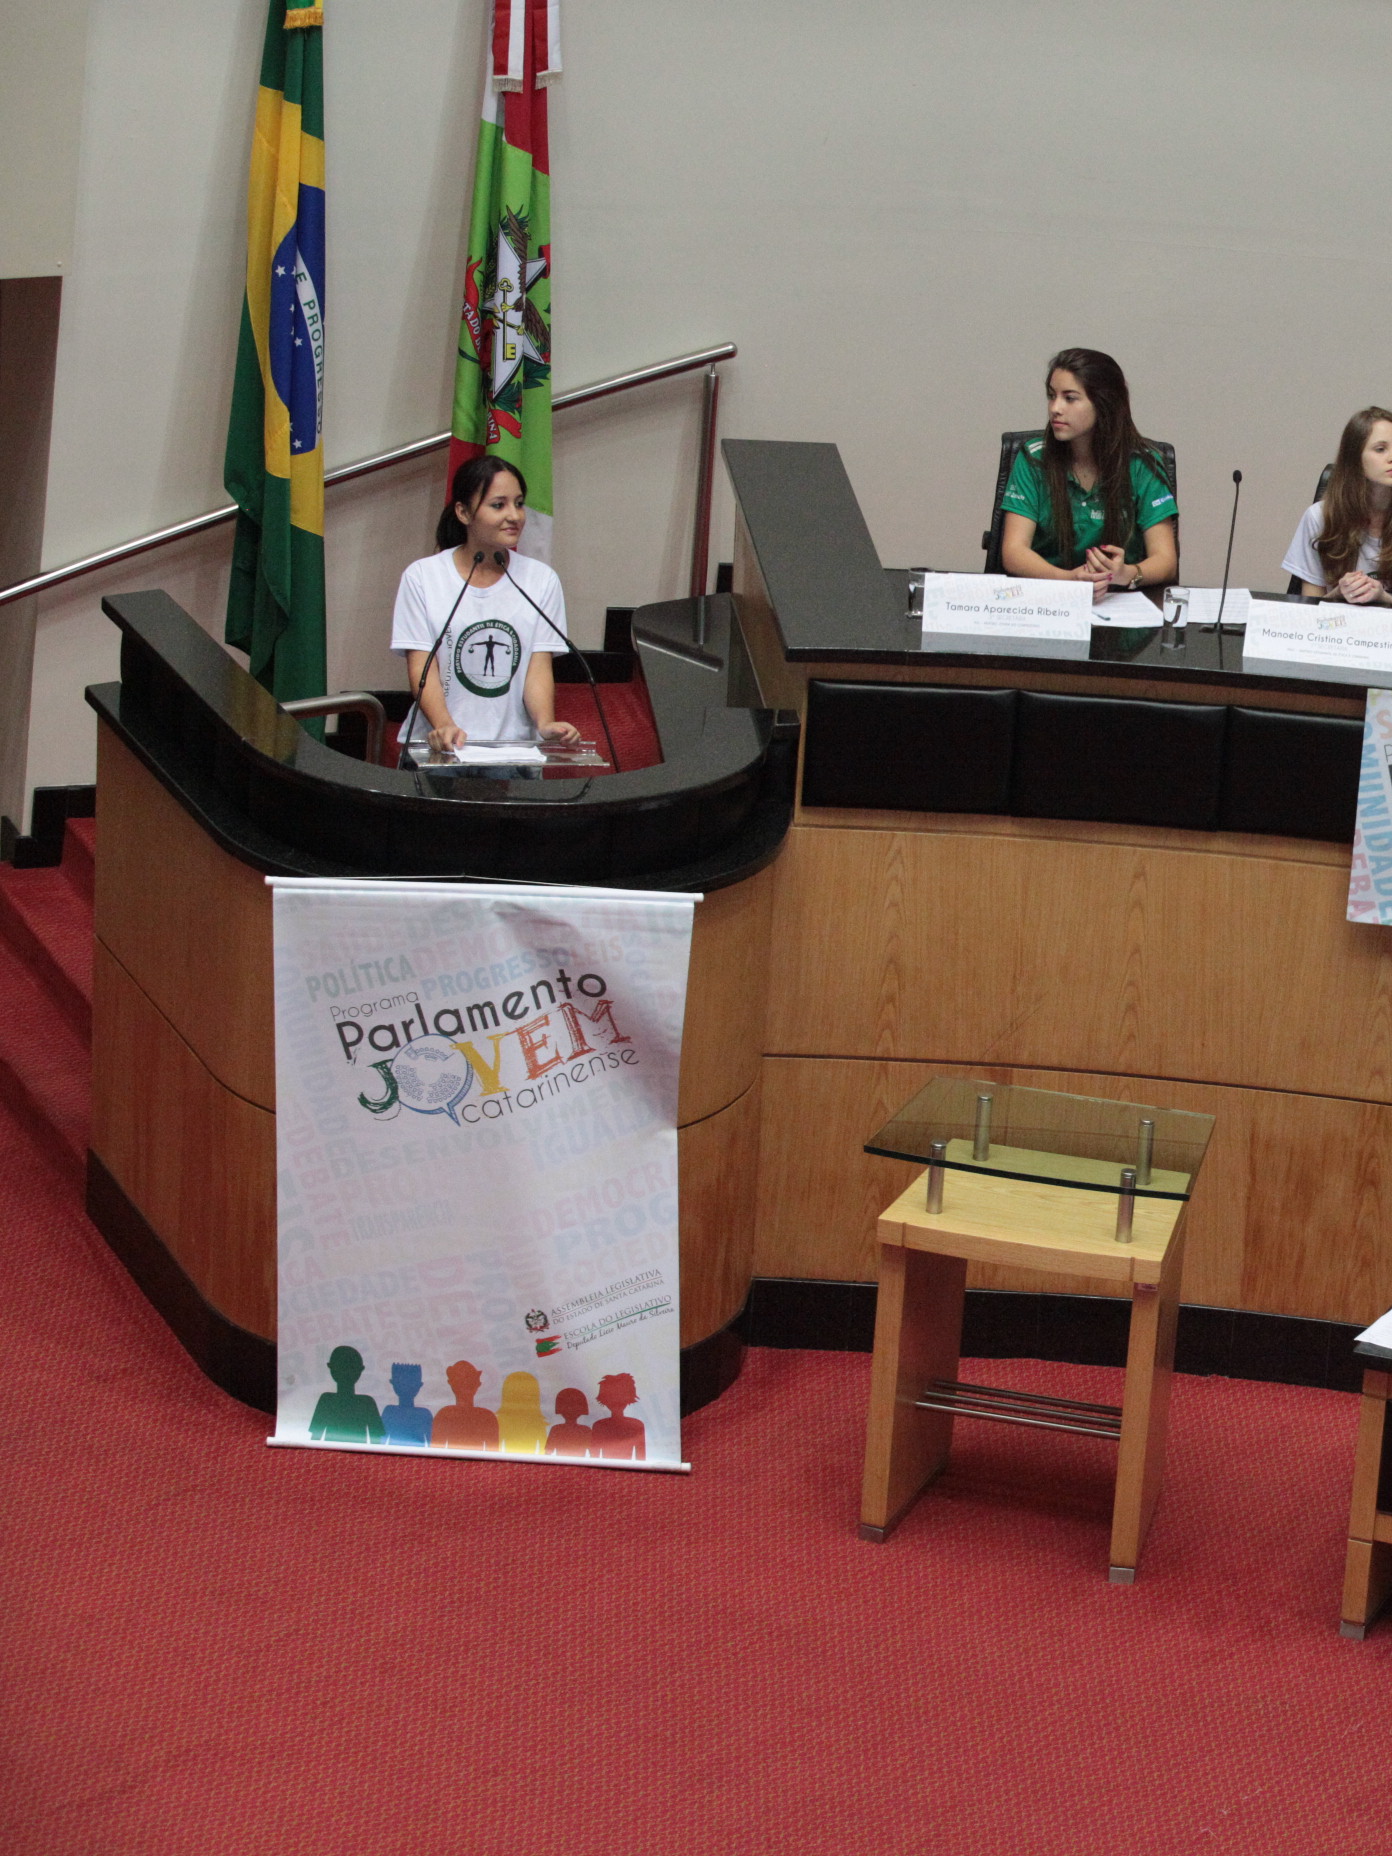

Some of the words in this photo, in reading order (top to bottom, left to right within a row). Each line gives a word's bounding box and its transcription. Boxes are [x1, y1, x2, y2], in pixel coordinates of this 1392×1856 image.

[463, 303, 481, 336] TADO
[945, 602, 980, 613] Tamara
[984, 604, 1034, 616] Aparecida
[1037, 607, 1070, 618] Ribeiro
[1307, 632, 1343, 645] Cristina
[305, 955, 417, 1003] POLÍTICA
[420, 946, 571, 1001] PROGRESSO
[329, 991, 420, 1023] Programa
[335, 969, 607, 1060] Parlamento
[461, 1048, 640, 1125] catarinense
[551, 1291, 603, 1317] ASSEMBLEIA
[605, 1268, 662, 1295] LEGISLATIVA
[553, 1316, 565, 1325] DO
[567, 1306, 593, 1321] ESTADO
[594, 1301, 604, 1309] DE
[605, 1292, 628, 1305] SANTA
[628, 1279, 665, 1296] CATARINA
[564, 1322, 598, 1340] ESCOLA
[598, 1314, 613, 1326] DO
[615, 1294, 672, 1320] LEGISLATIVO
[567, 1333, 598, 1350] Deputado
[638, 1313, 648, 1322] da
